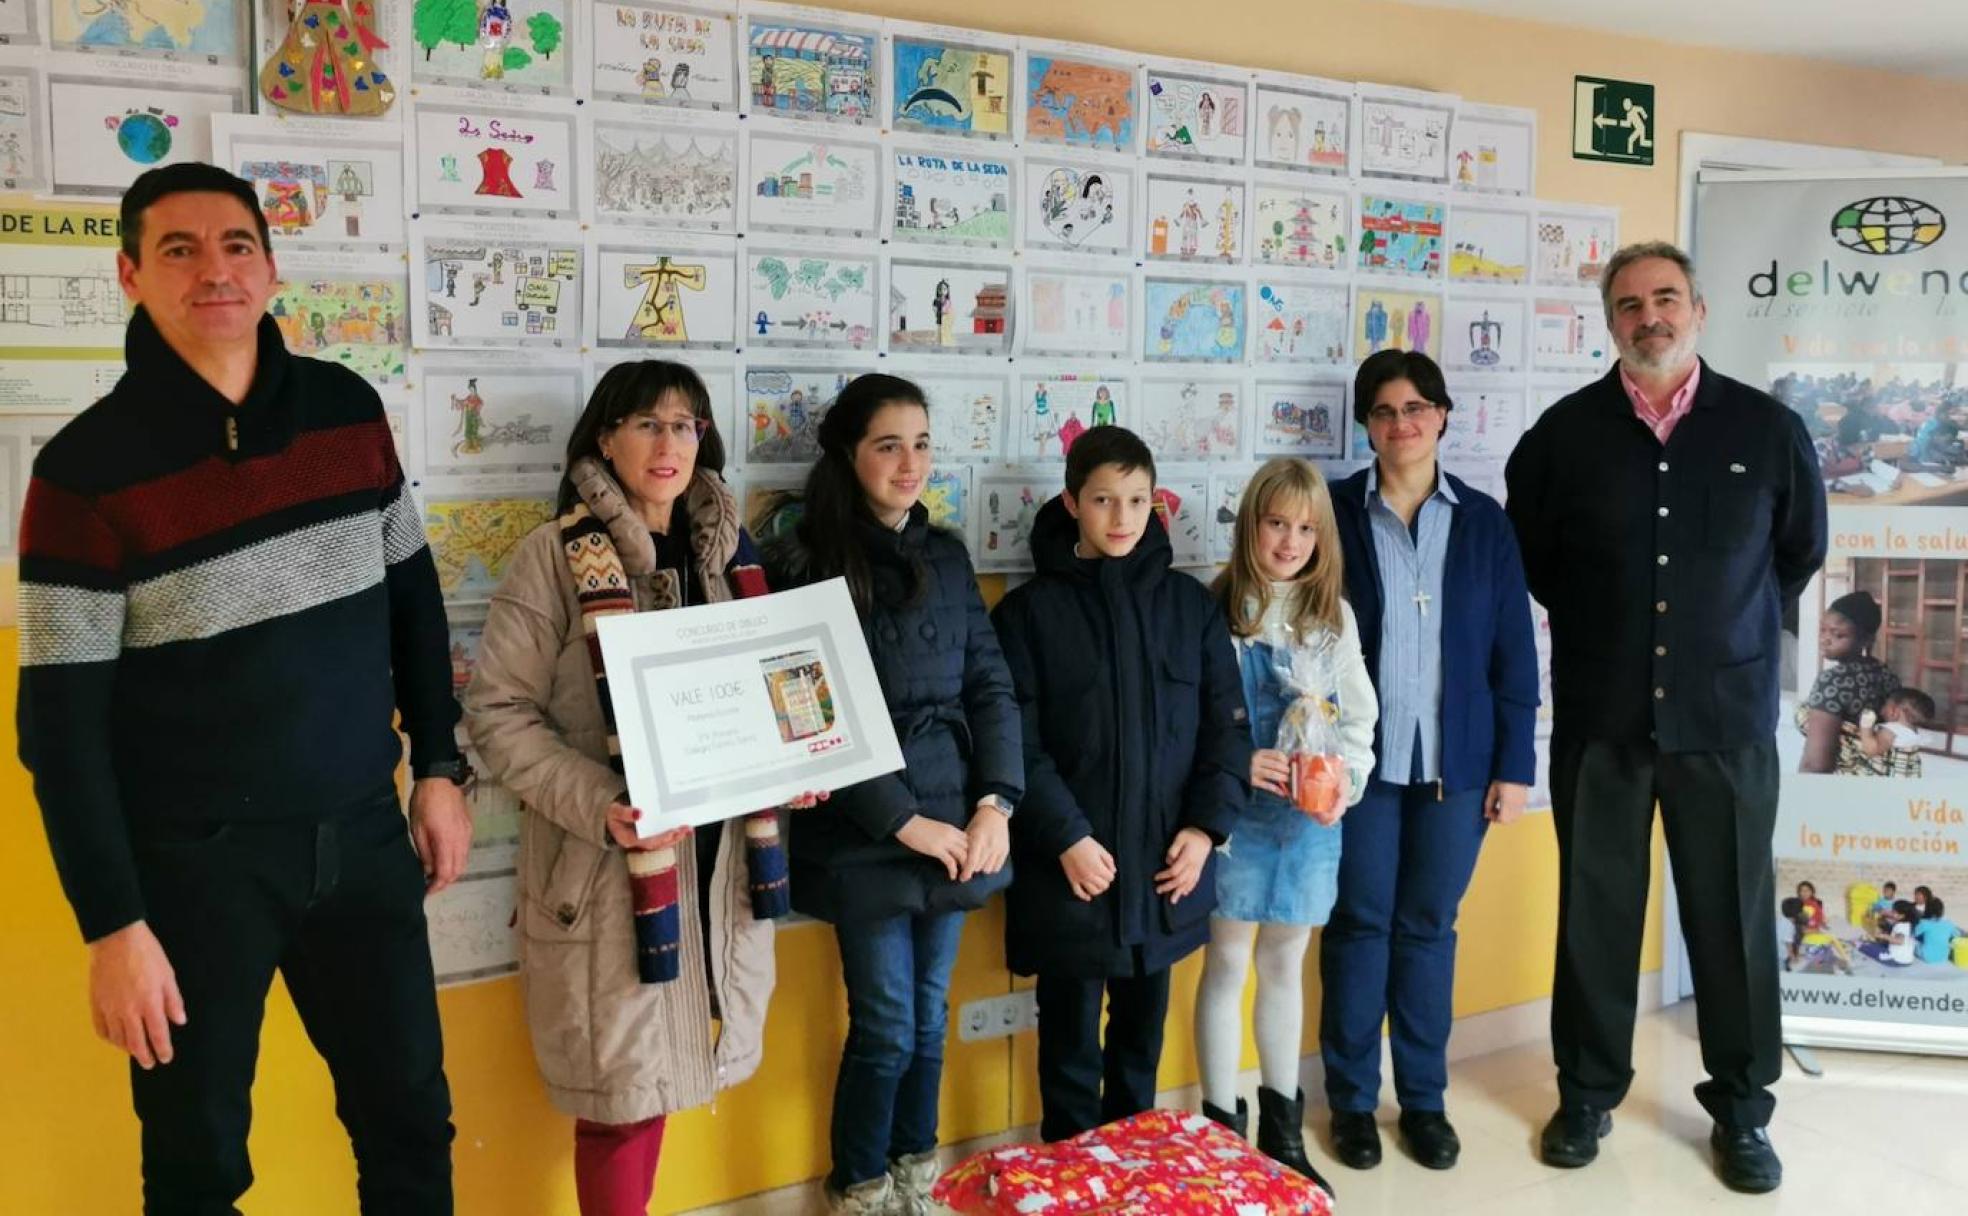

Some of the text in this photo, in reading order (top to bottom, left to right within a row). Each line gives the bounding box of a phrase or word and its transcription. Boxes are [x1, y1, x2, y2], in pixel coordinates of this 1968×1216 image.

[898, 155, 1007, 176] LA RUTA DE LA SEDA
[2, 214, 34, 233] DE
[44, 215, 75, 235] LA
[1834, 532, 1876, 549] con
[1884, 525, 1908, 551] la
[669, 688, 704, 707] VALE
[1907, 799, 1963, 825] Vida
[1800, 823, 1960, 857] la promoción
